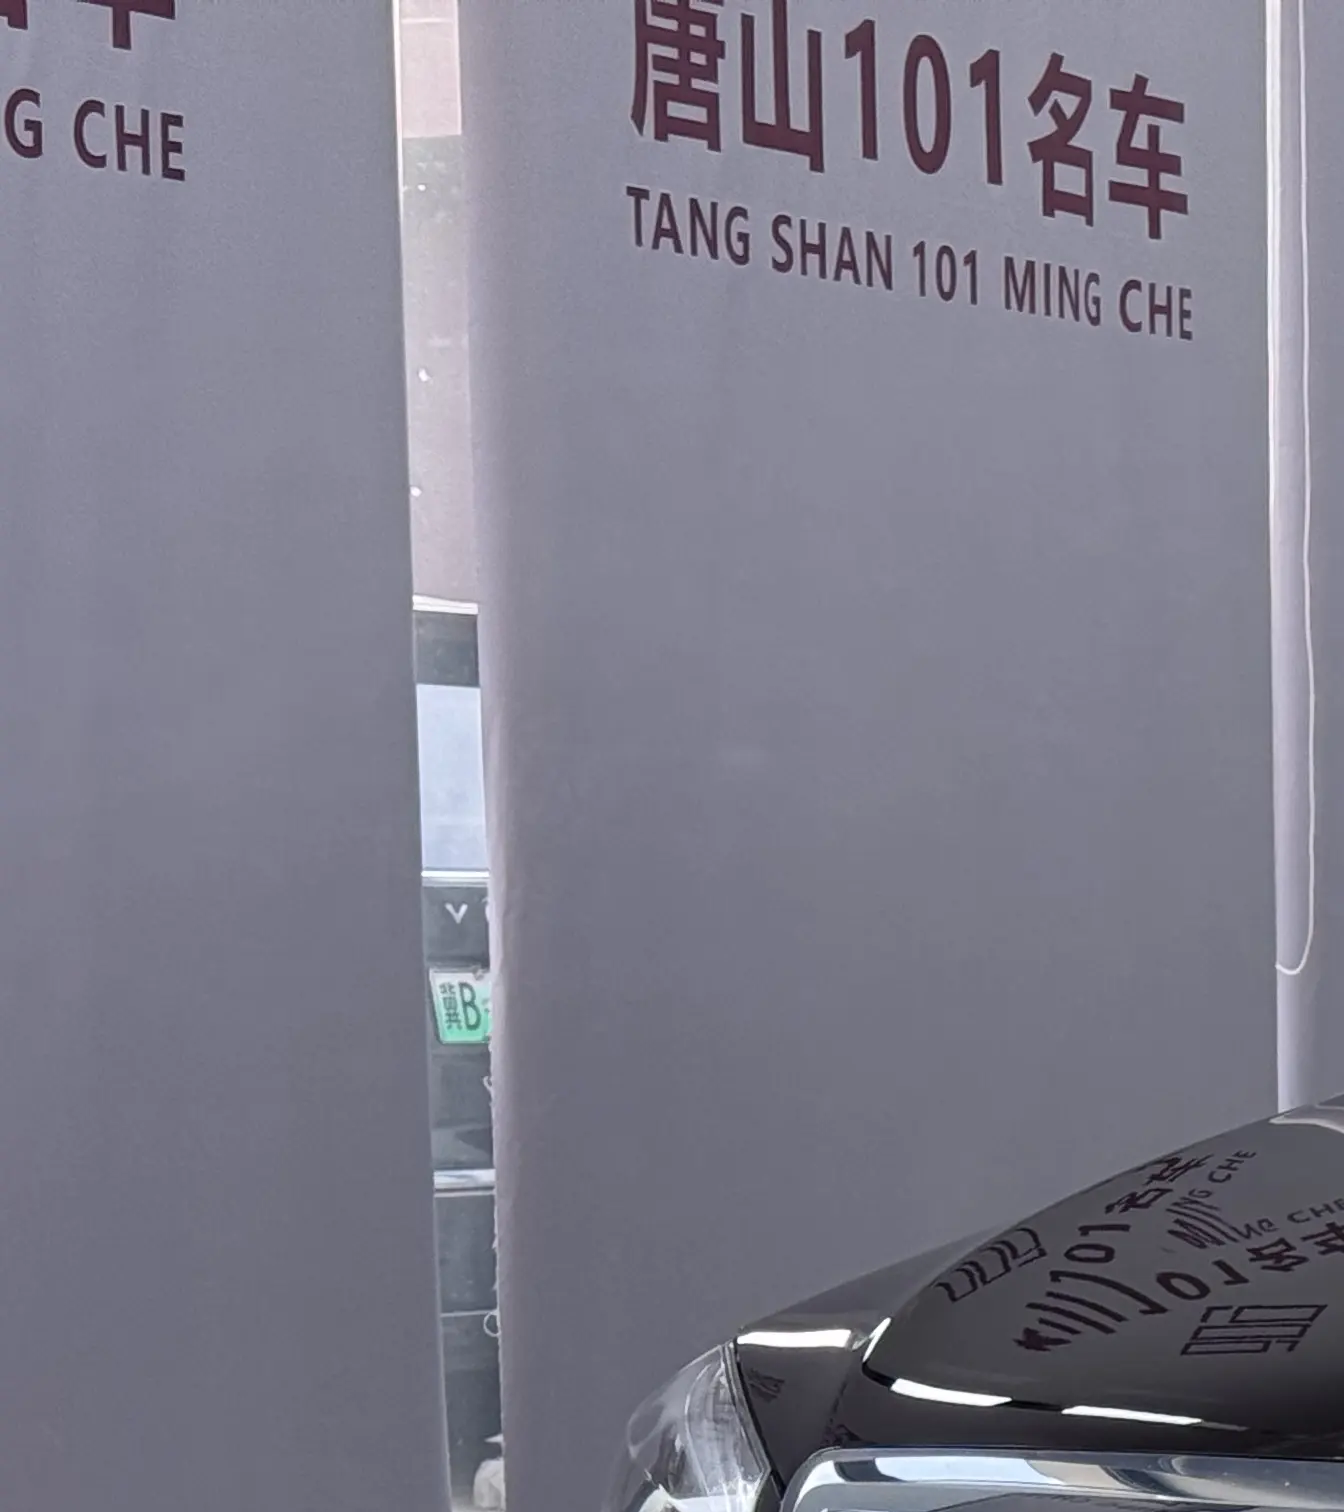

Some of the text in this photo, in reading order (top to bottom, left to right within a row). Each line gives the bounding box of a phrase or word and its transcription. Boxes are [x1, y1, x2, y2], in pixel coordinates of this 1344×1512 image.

[73, 99, 186, 182] CHE
[630, 0, 1189, 240] 唐山101名车
[625, 185, 1193, 341] TANG SHAN 101 MING CHE
